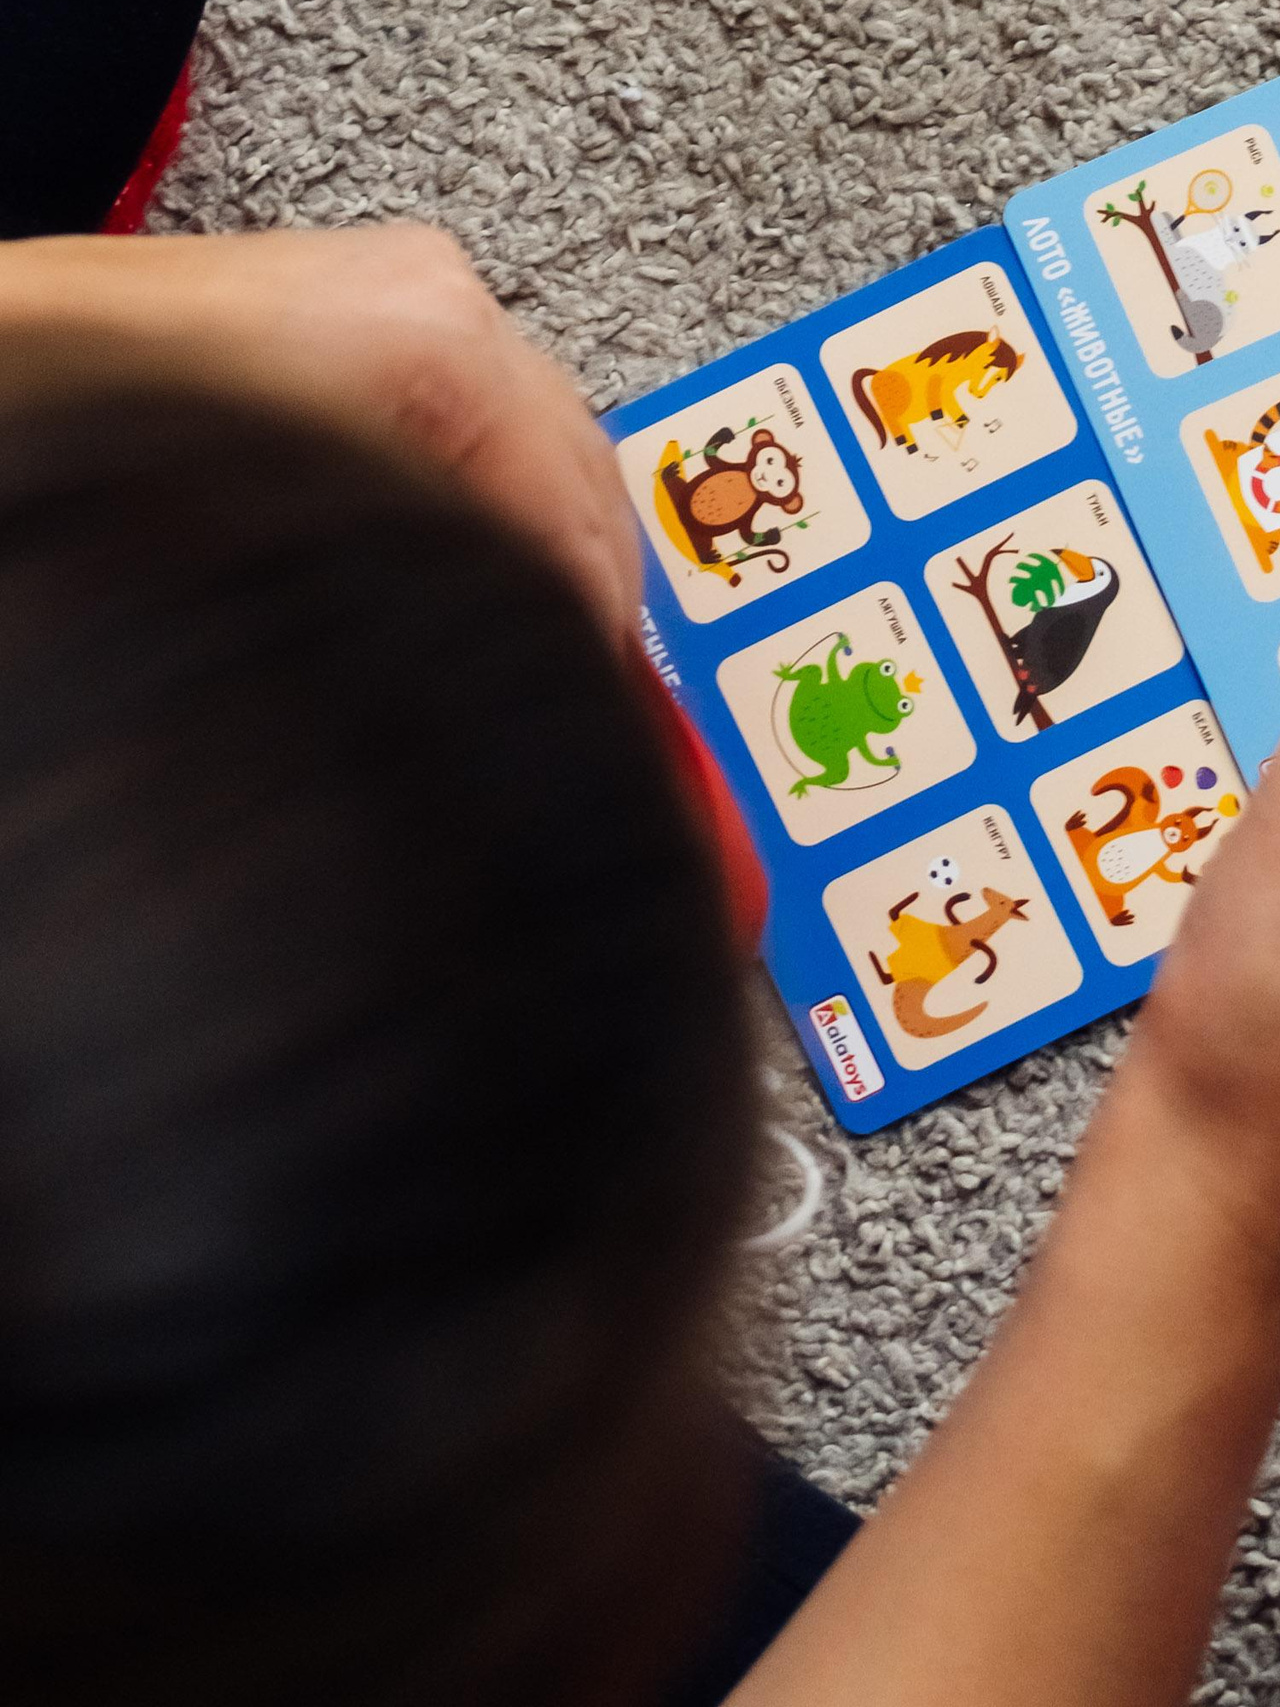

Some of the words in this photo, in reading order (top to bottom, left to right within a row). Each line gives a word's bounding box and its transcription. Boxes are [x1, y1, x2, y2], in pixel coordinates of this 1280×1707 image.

[1244, 137, 1263, 165] РЫСЬ
[980, 276, 1006, 316] ЛОШАДЬ
[1022, 217, 1071, 281] ЛОТО
[1057, 286, 1144, 464] «ЖИВОТНЫЕ»
[775, 378, 804, 428] ОБЕЗЬЯНА
[1086, 492, 1109, 527] ТУКАН
[879, 598, 906, 644] ЛЯГУШКА
[1192, 711, 1215, 746] БЕЛКА
[983, 815, 1012, 860] КЕНГУРУ
